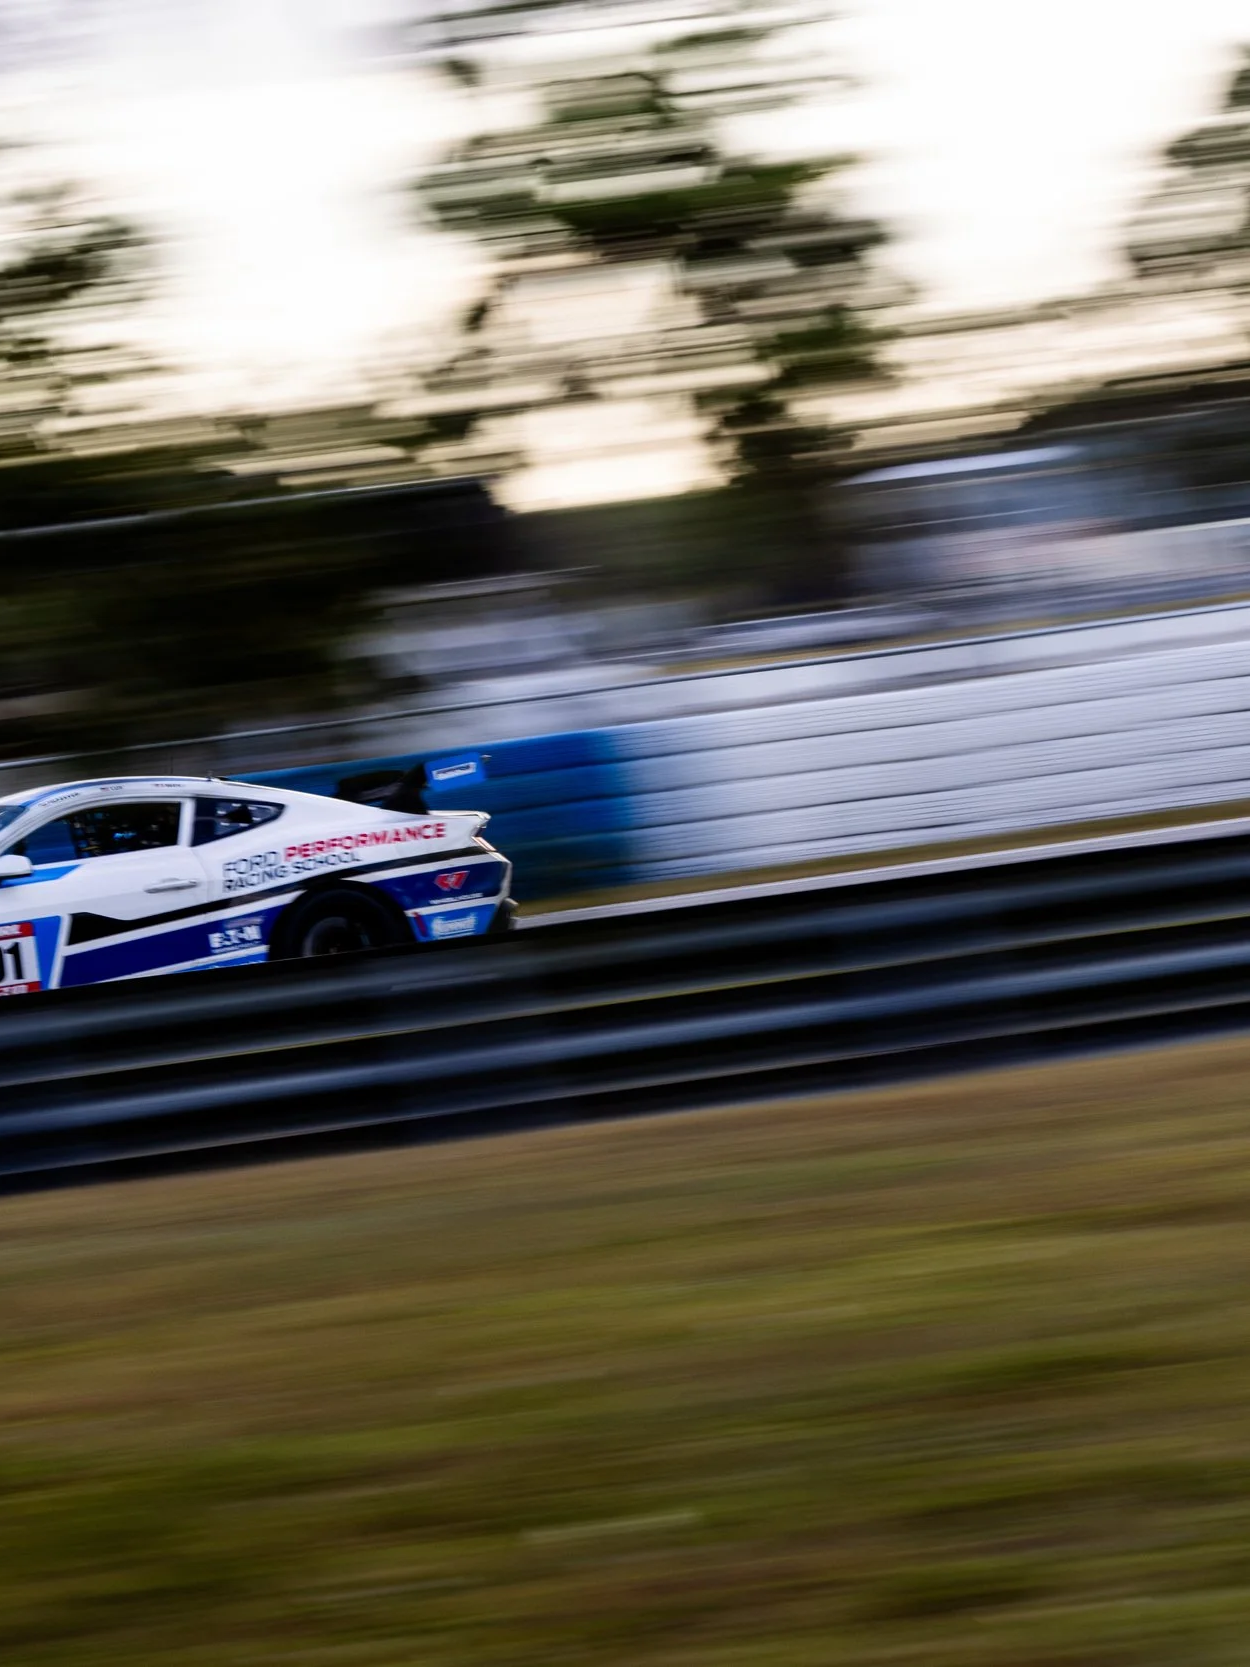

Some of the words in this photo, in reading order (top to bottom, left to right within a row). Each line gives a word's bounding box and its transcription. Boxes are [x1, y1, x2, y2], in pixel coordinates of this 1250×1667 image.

[222, 850, 280, 877] FORD
[284, 823, 447, 862] PERFORMANCE
[222, 865, 290, 893] RACING
[291, 851, 362, 875] SCHOOL
